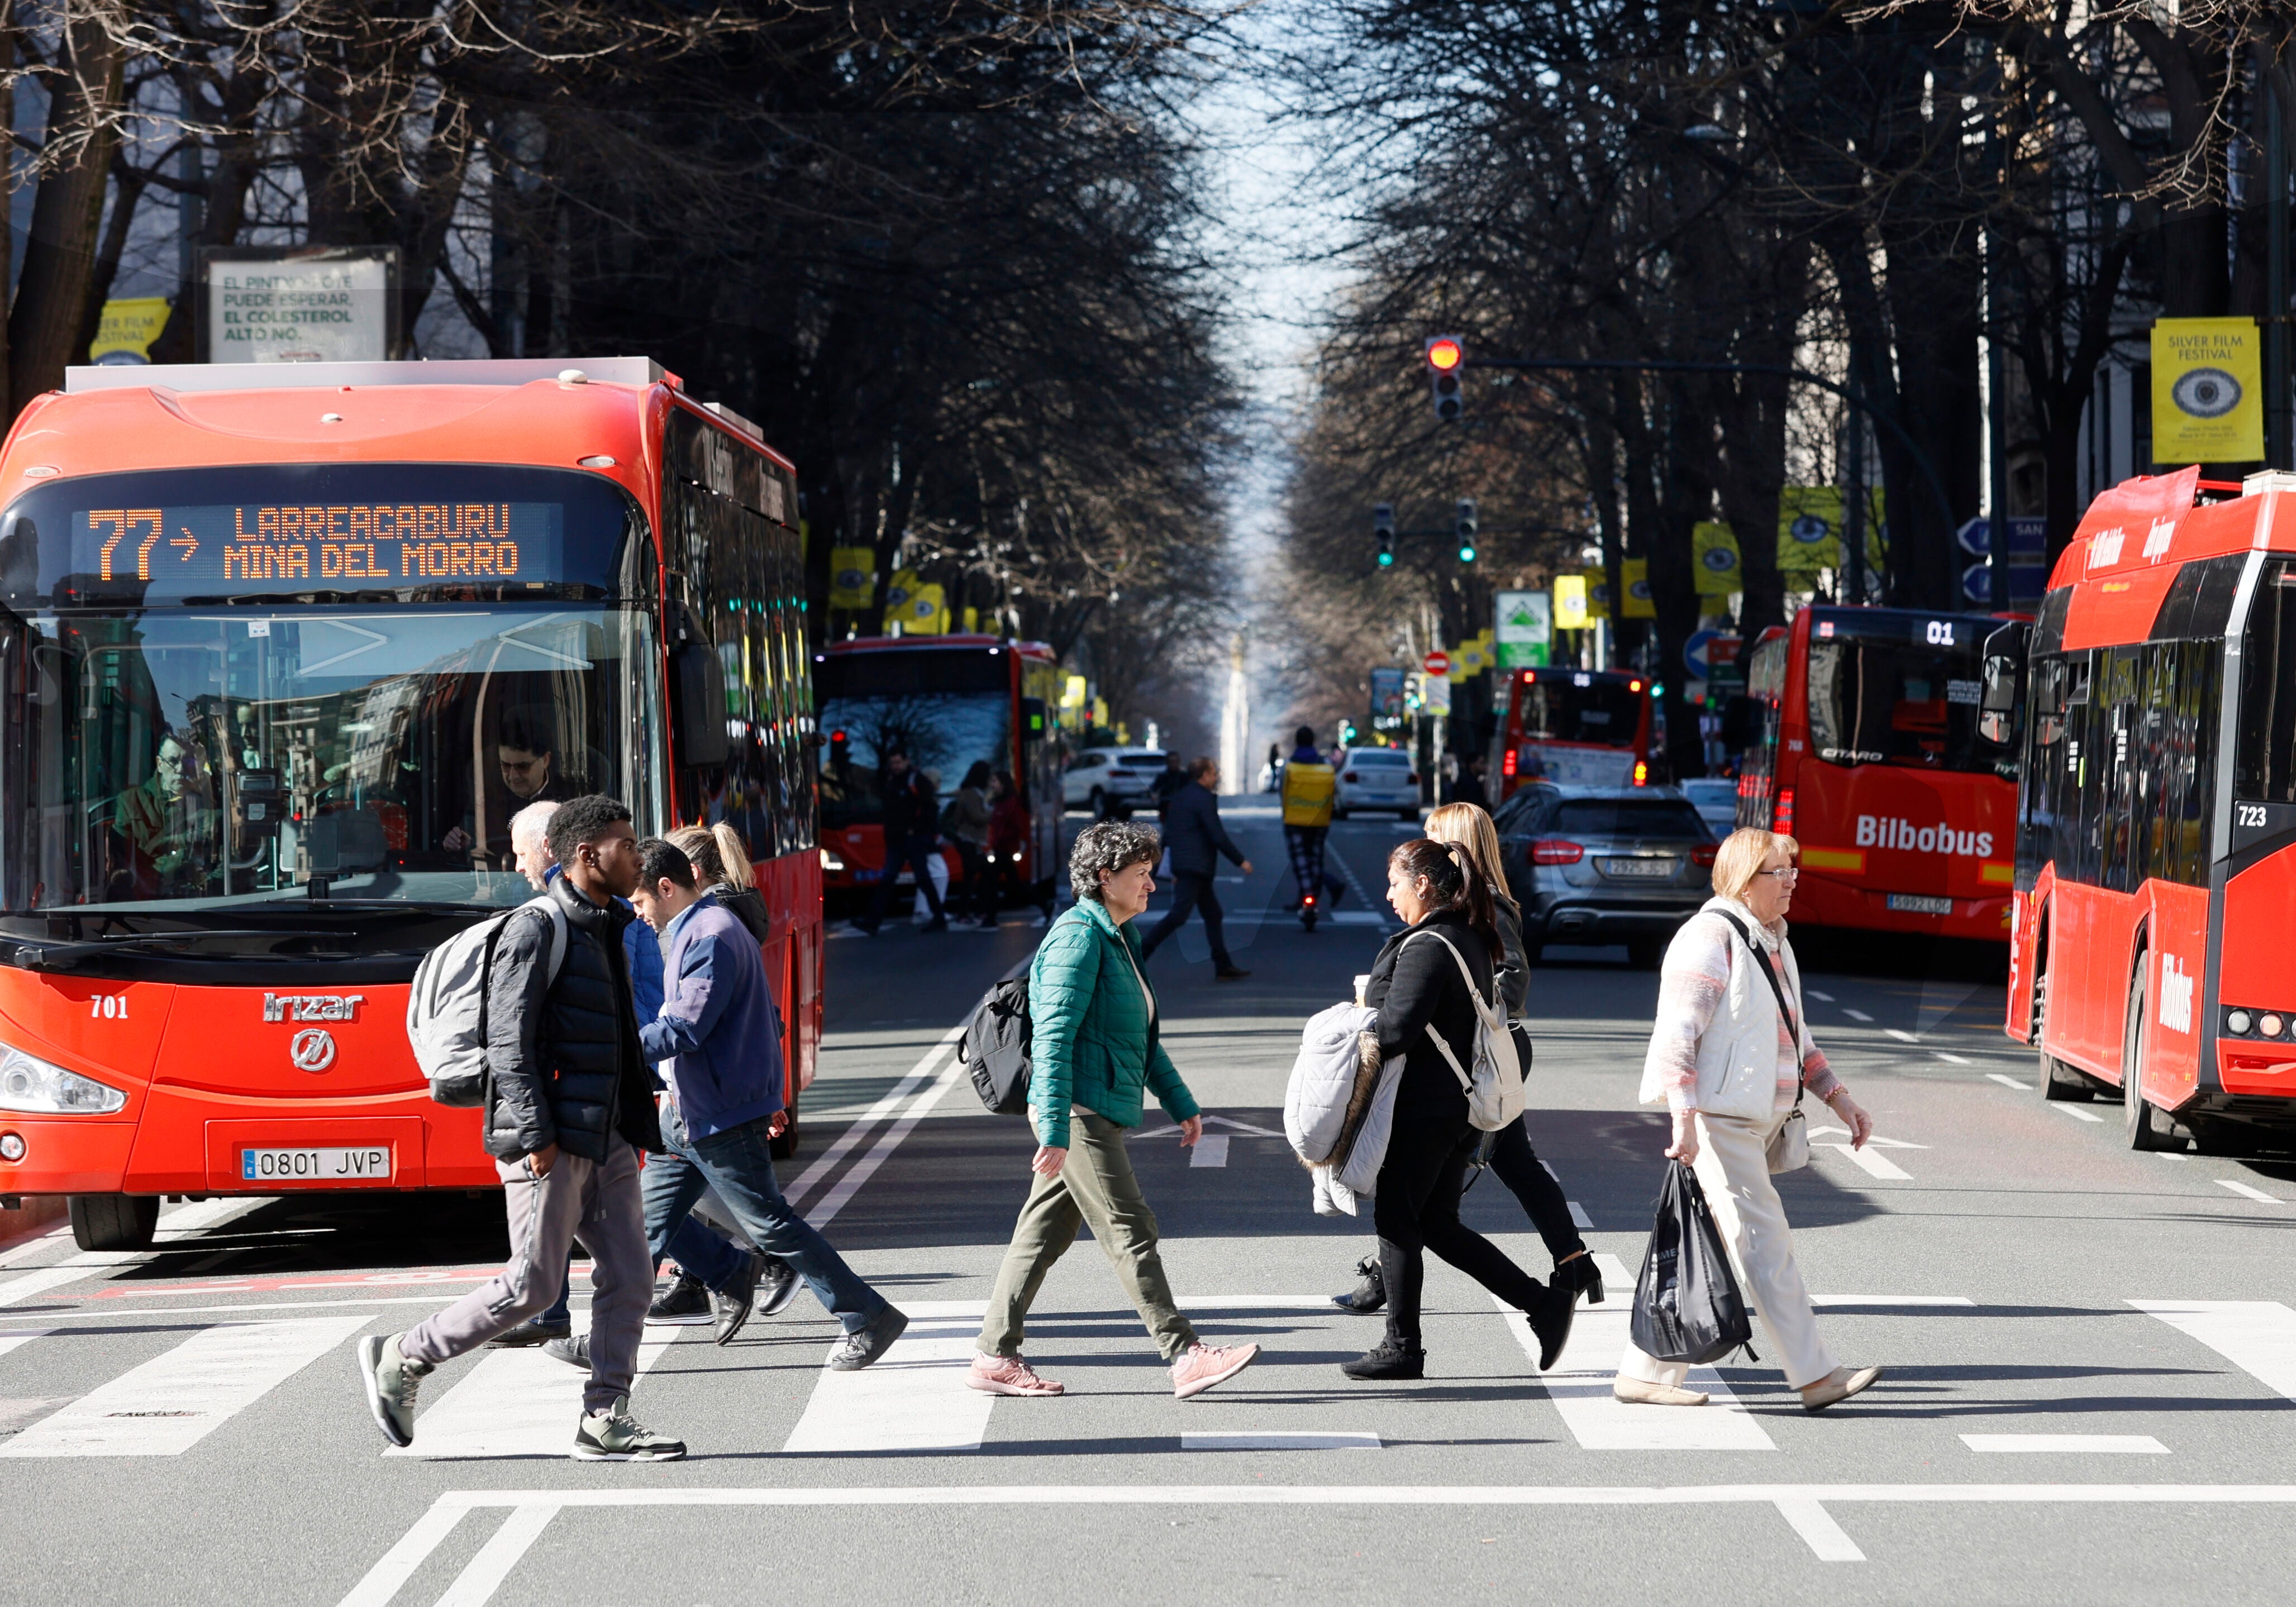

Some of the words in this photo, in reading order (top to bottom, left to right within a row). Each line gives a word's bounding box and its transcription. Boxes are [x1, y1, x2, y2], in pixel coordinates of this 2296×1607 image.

[224, 276, 240, 289] EL
[224, 294, 273, 307] PUEDE
[280, 293, 354, 307] ESPERAR,
[124, 316, 154, 327] FILM
[224, 311, 241, 323] EL
[247, 310, 354, 323] COLESTEROL
[224, 328, 267, 341] ALTO
[271, 327, 302, 340] NO.
[2168, 336, 2208, 348] SILVER
[2214, 335, 2243, 347] FILM
[2179, 349, 2233, 361] FESTIVAL
[2015, 524, 2043, 536] SAN
[89, 508, 163, 581] 77
[235, 503, 509, 542] LARREAGABURU
[223, 544, 309, 579] MINA
[321, 542, 389, 578] DEL
[402, 541, 518, 576] MORRO
[1926, 620, 1955, 646] 01
[1822, 747, 1884, 762] CITARO
[2238, 805, 2266, 827] 723
[1855, 814, 1994, 858] Bilbobus
[90, 994, 128, 1019] 701
[260, 1153, 318, 1175] 0801
[335, 1151, 382, 1174] JVP
